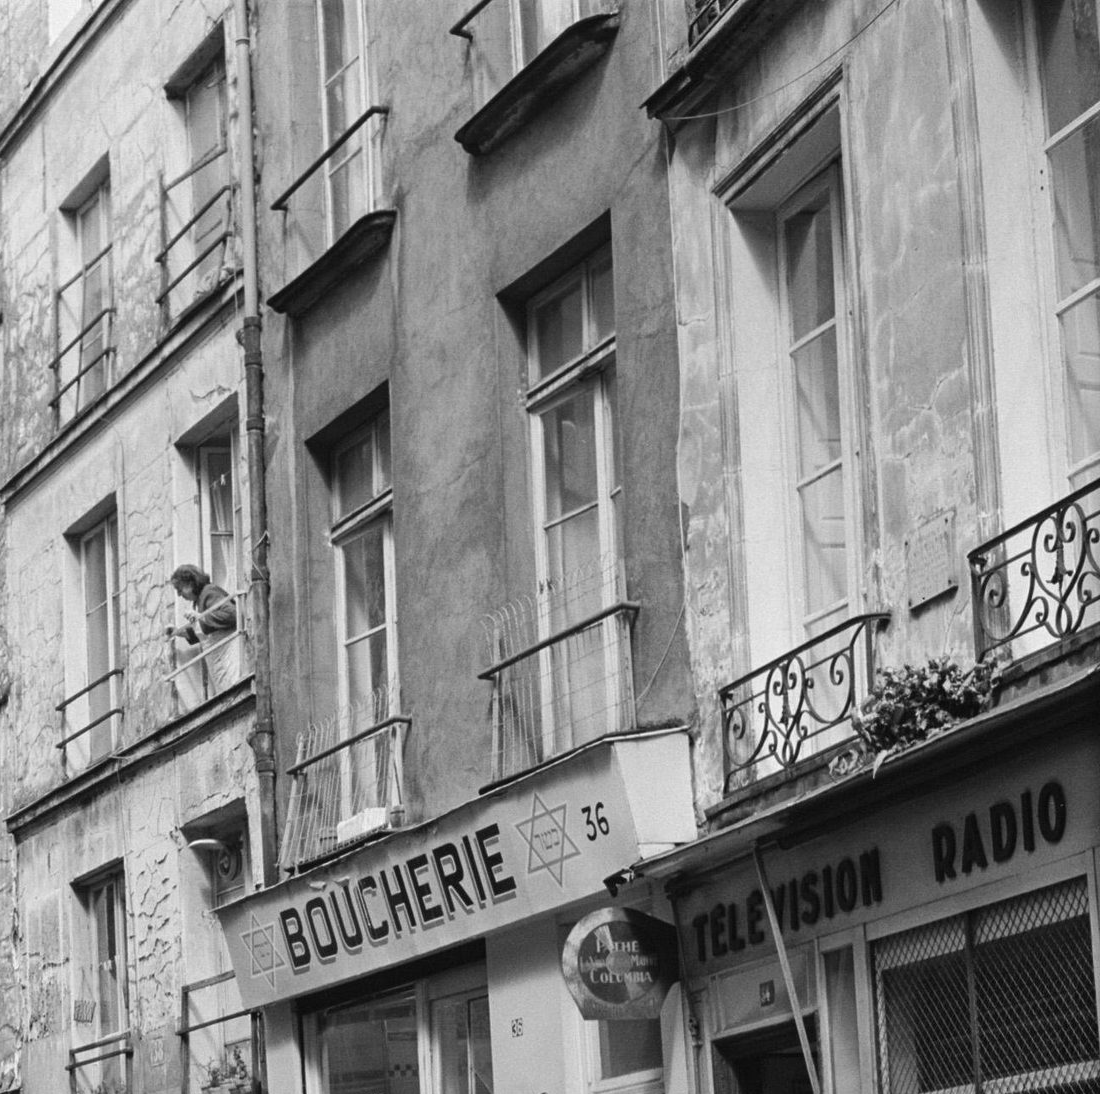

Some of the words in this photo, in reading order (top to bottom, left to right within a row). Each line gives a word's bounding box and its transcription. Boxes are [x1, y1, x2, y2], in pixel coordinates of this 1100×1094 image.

[581, 801, 610, 841] 36
[931, 780, 1068, 884] RADIO
[279, 823, 517, 973] BOUCHERIE
[590, 968, 653, 984] COLUMBIA
